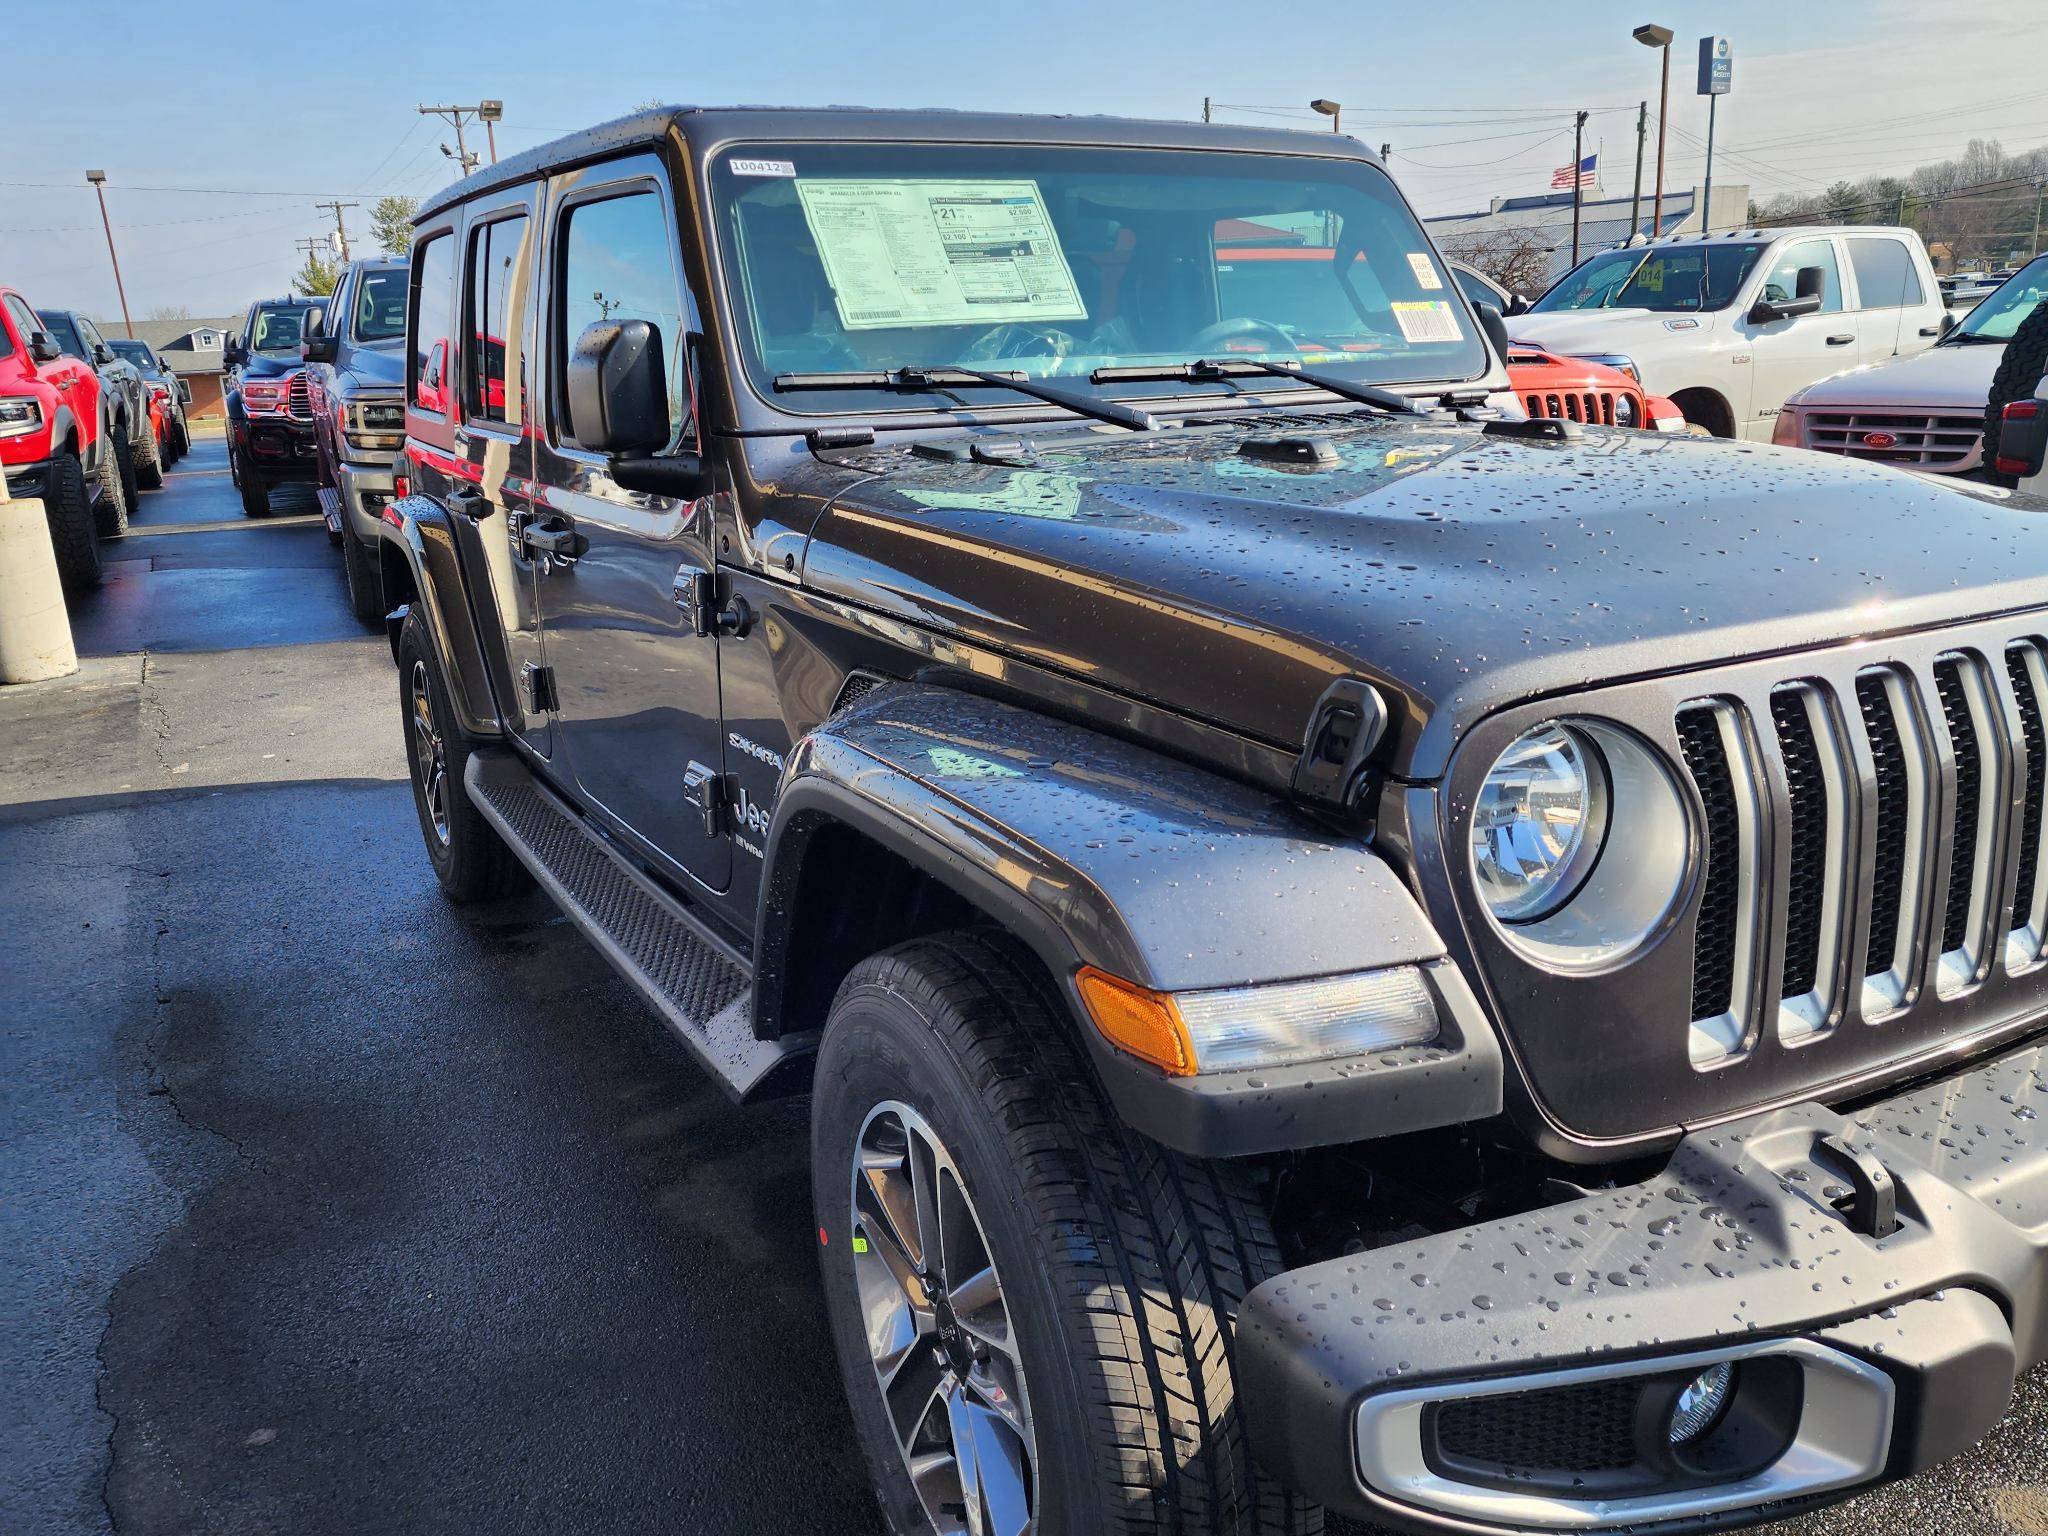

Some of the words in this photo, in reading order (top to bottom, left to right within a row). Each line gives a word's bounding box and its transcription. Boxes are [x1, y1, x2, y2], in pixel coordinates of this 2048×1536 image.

[732, 161, 781, 172] 100412
[940, 207, 956, 219] 21
[1870, 435, 1890, 444] Ford
[729, 732, 784, 773] SAHARA
[733, 787, 770, 839] Jee
